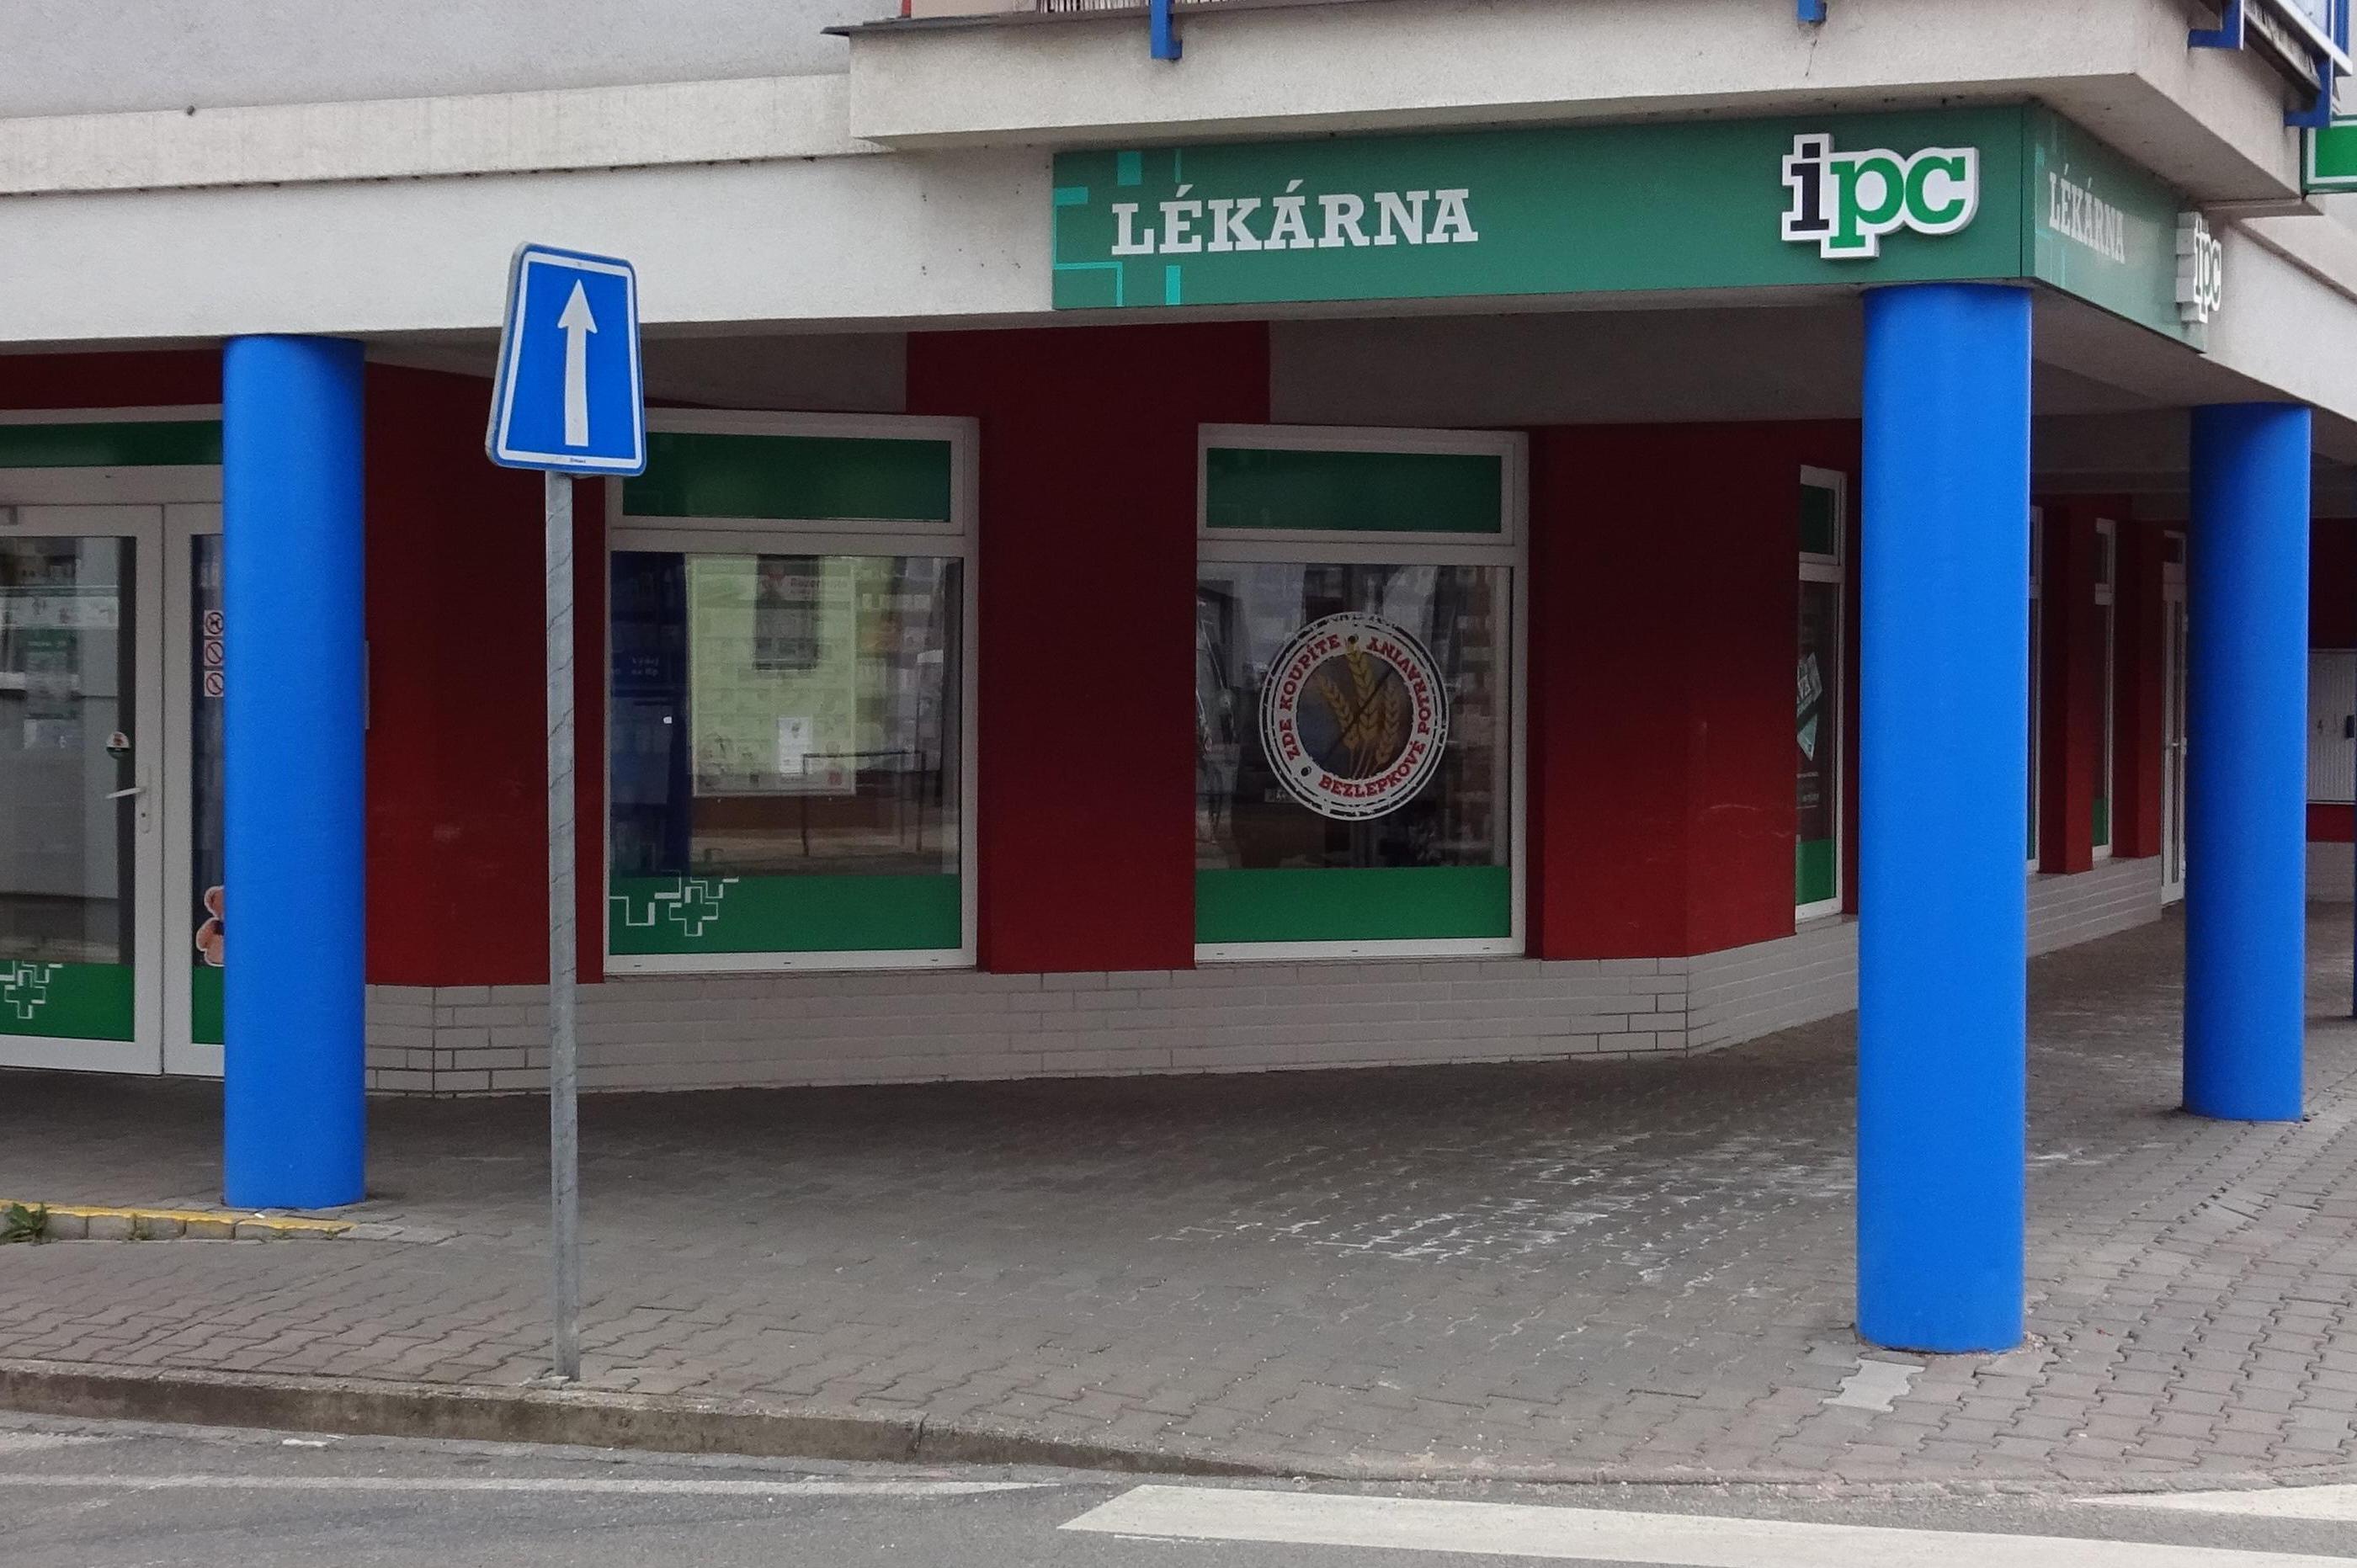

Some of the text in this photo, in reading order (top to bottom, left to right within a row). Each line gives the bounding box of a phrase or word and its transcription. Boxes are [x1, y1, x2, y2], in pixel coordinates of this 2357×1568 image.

[1111, 179, 1479, 256] LÉKÁRNA
[1789, 141, 1966, 249] ipc
[2049, 162, 2126, 264] LÉKÁRNA
[2195, 214, 2222, 322] ipc
[1279, 633, 1341, 761] ZDE KOUPÍTE
[1318, 635, 1432, 799] BEZLEPKOVÉ POTRAVINY
